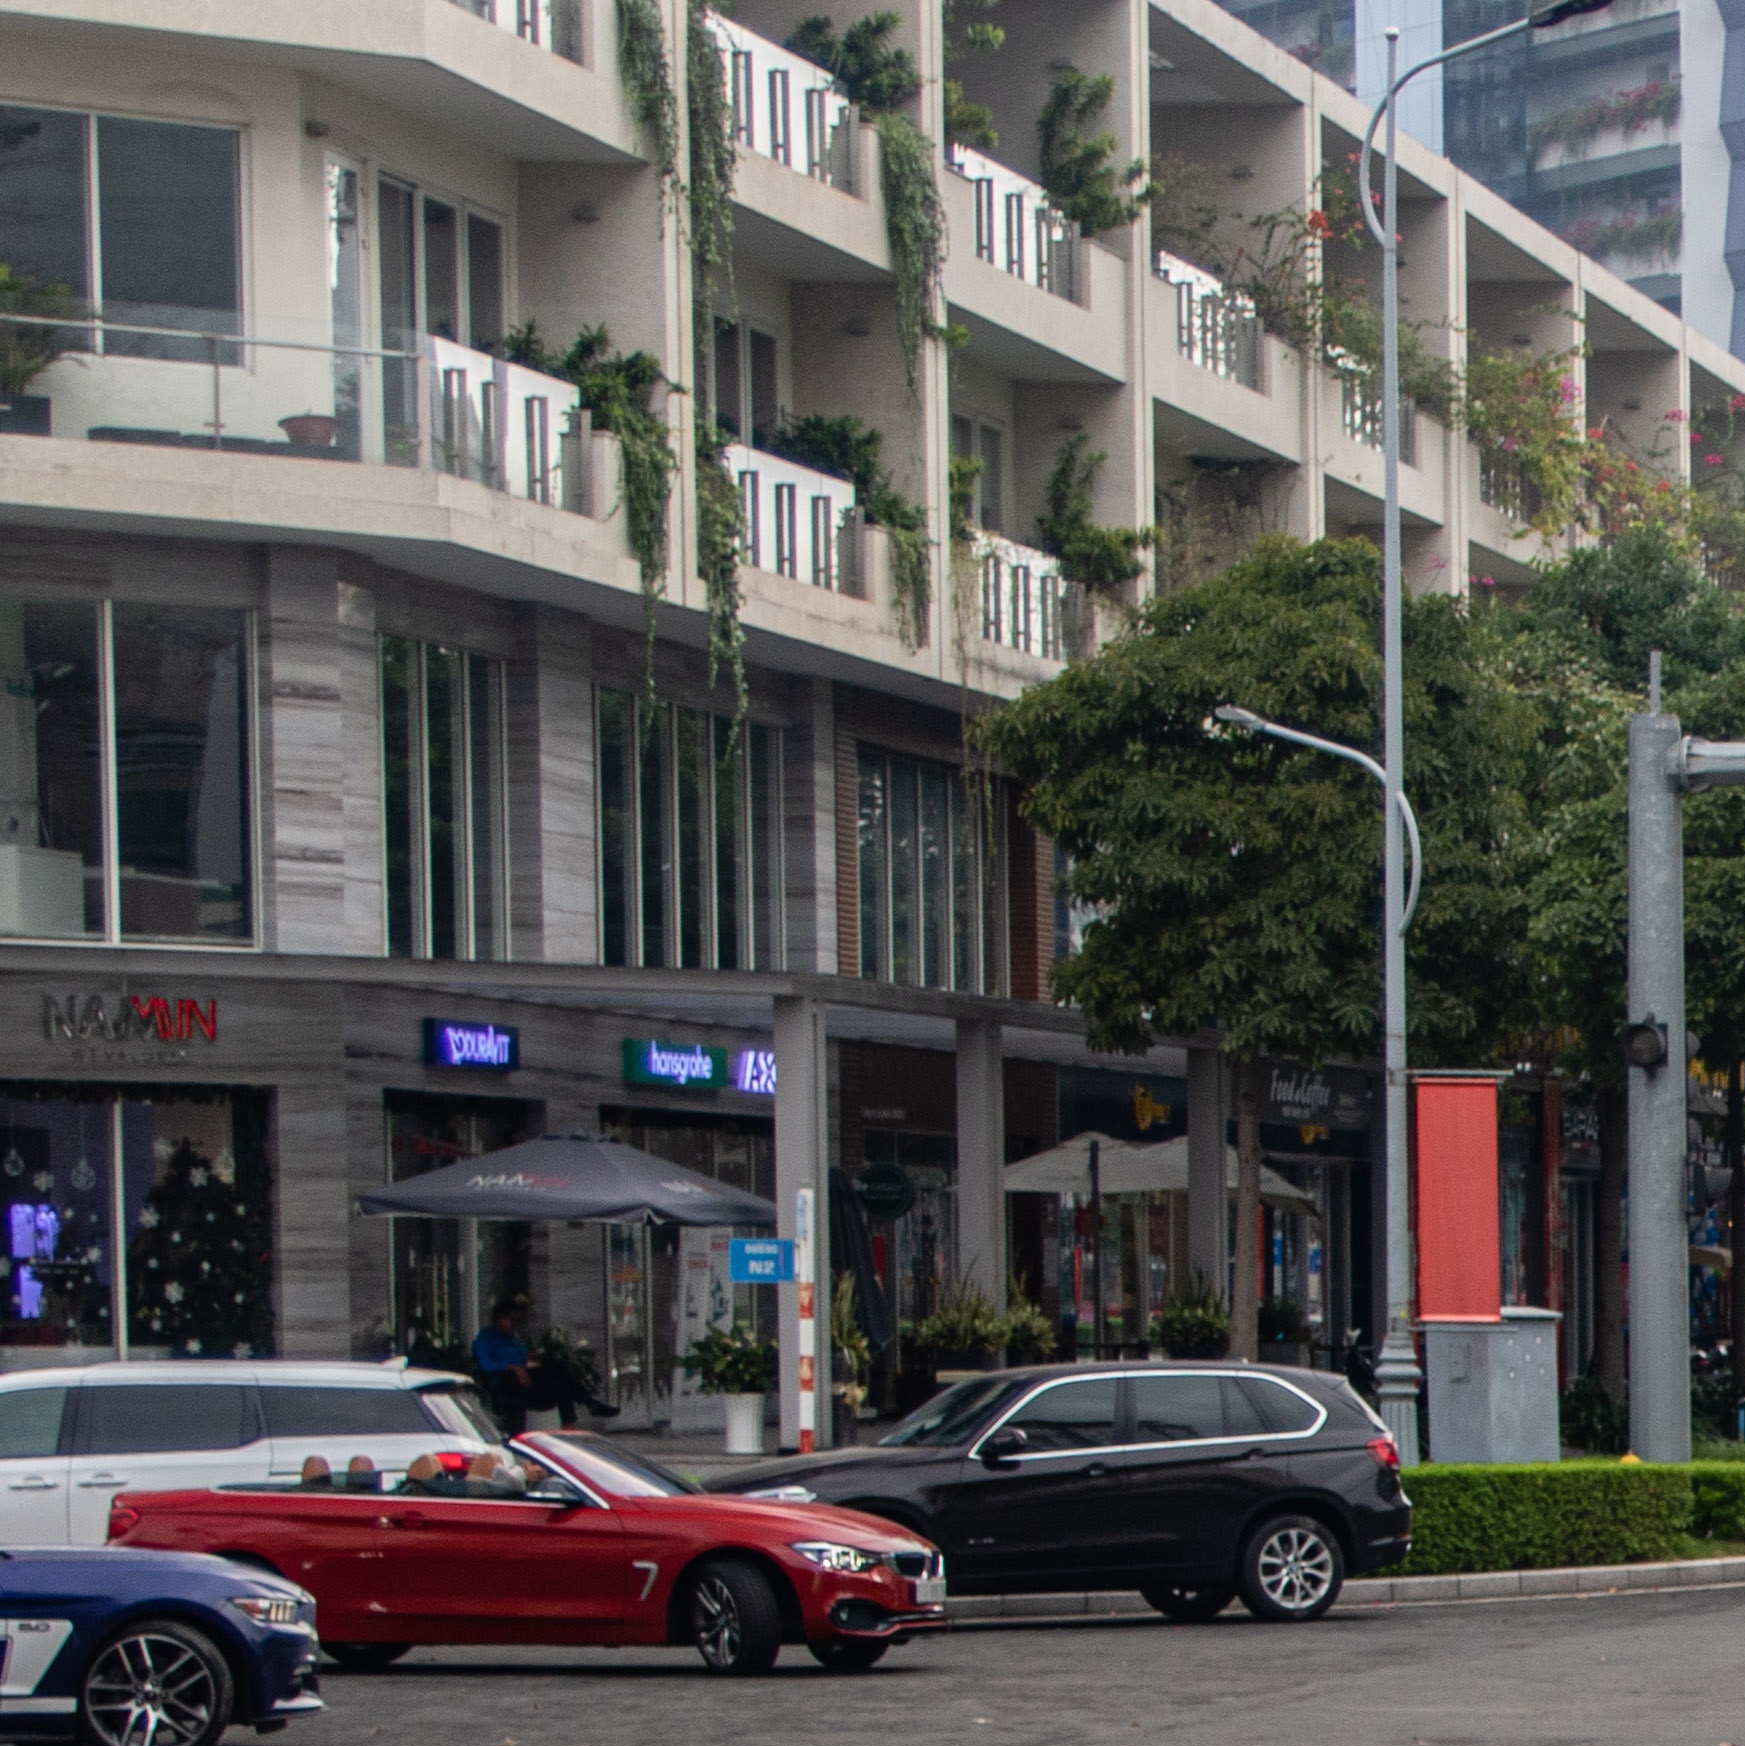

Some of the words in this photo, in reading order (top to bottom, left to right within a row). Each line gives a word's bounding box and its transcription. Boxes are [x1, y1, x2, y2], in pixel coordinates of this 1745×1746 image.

[650, 1040, 713, 1085] hansgrohe
[741, 1049, 777, 1094] AX
[748, 1260, 775, 1275] N2
